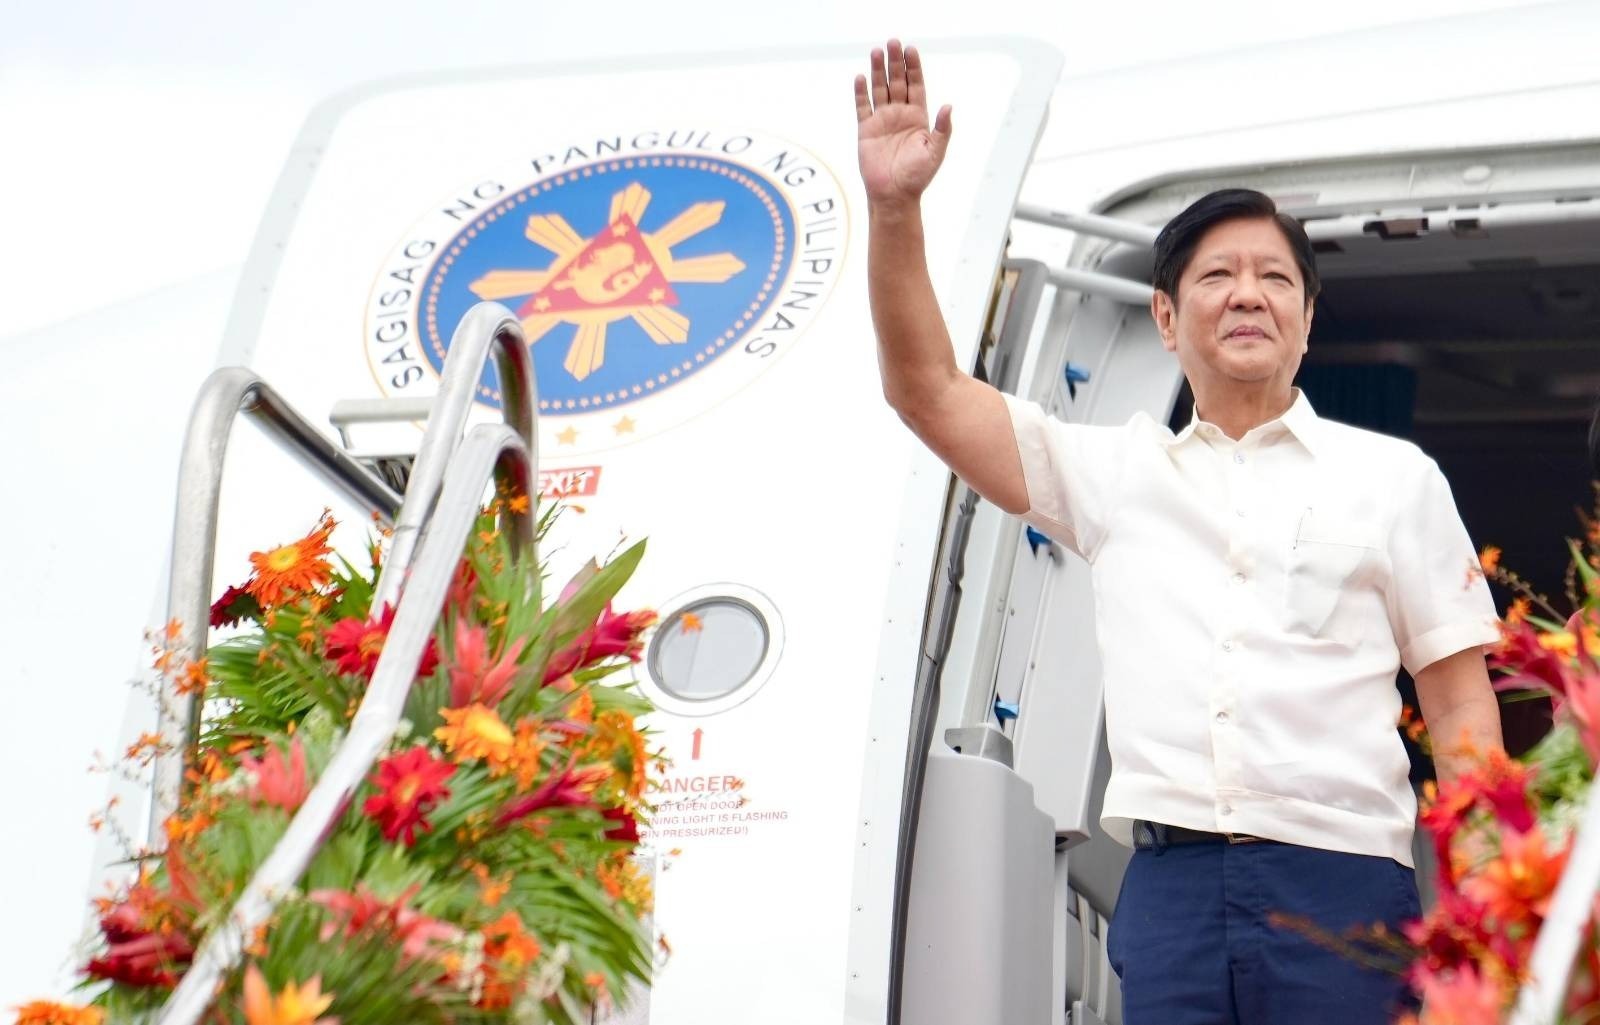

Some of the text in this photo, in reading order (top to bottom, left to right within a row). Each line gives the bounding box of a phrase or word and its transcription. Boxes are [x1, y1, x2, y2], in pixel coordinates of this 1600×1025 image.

[375, 130, 837, 390] SAGISAG NG PANGULO NG PILIPINAS
[677, 801, 708, 811] OPEN
[683, 813, 715, 823] LIGHT
[719, 812, 728, 821] IS
[732, 810, 789, 821] FLASHING
[662, 825, 750, 838] PRESSURIZED!)
